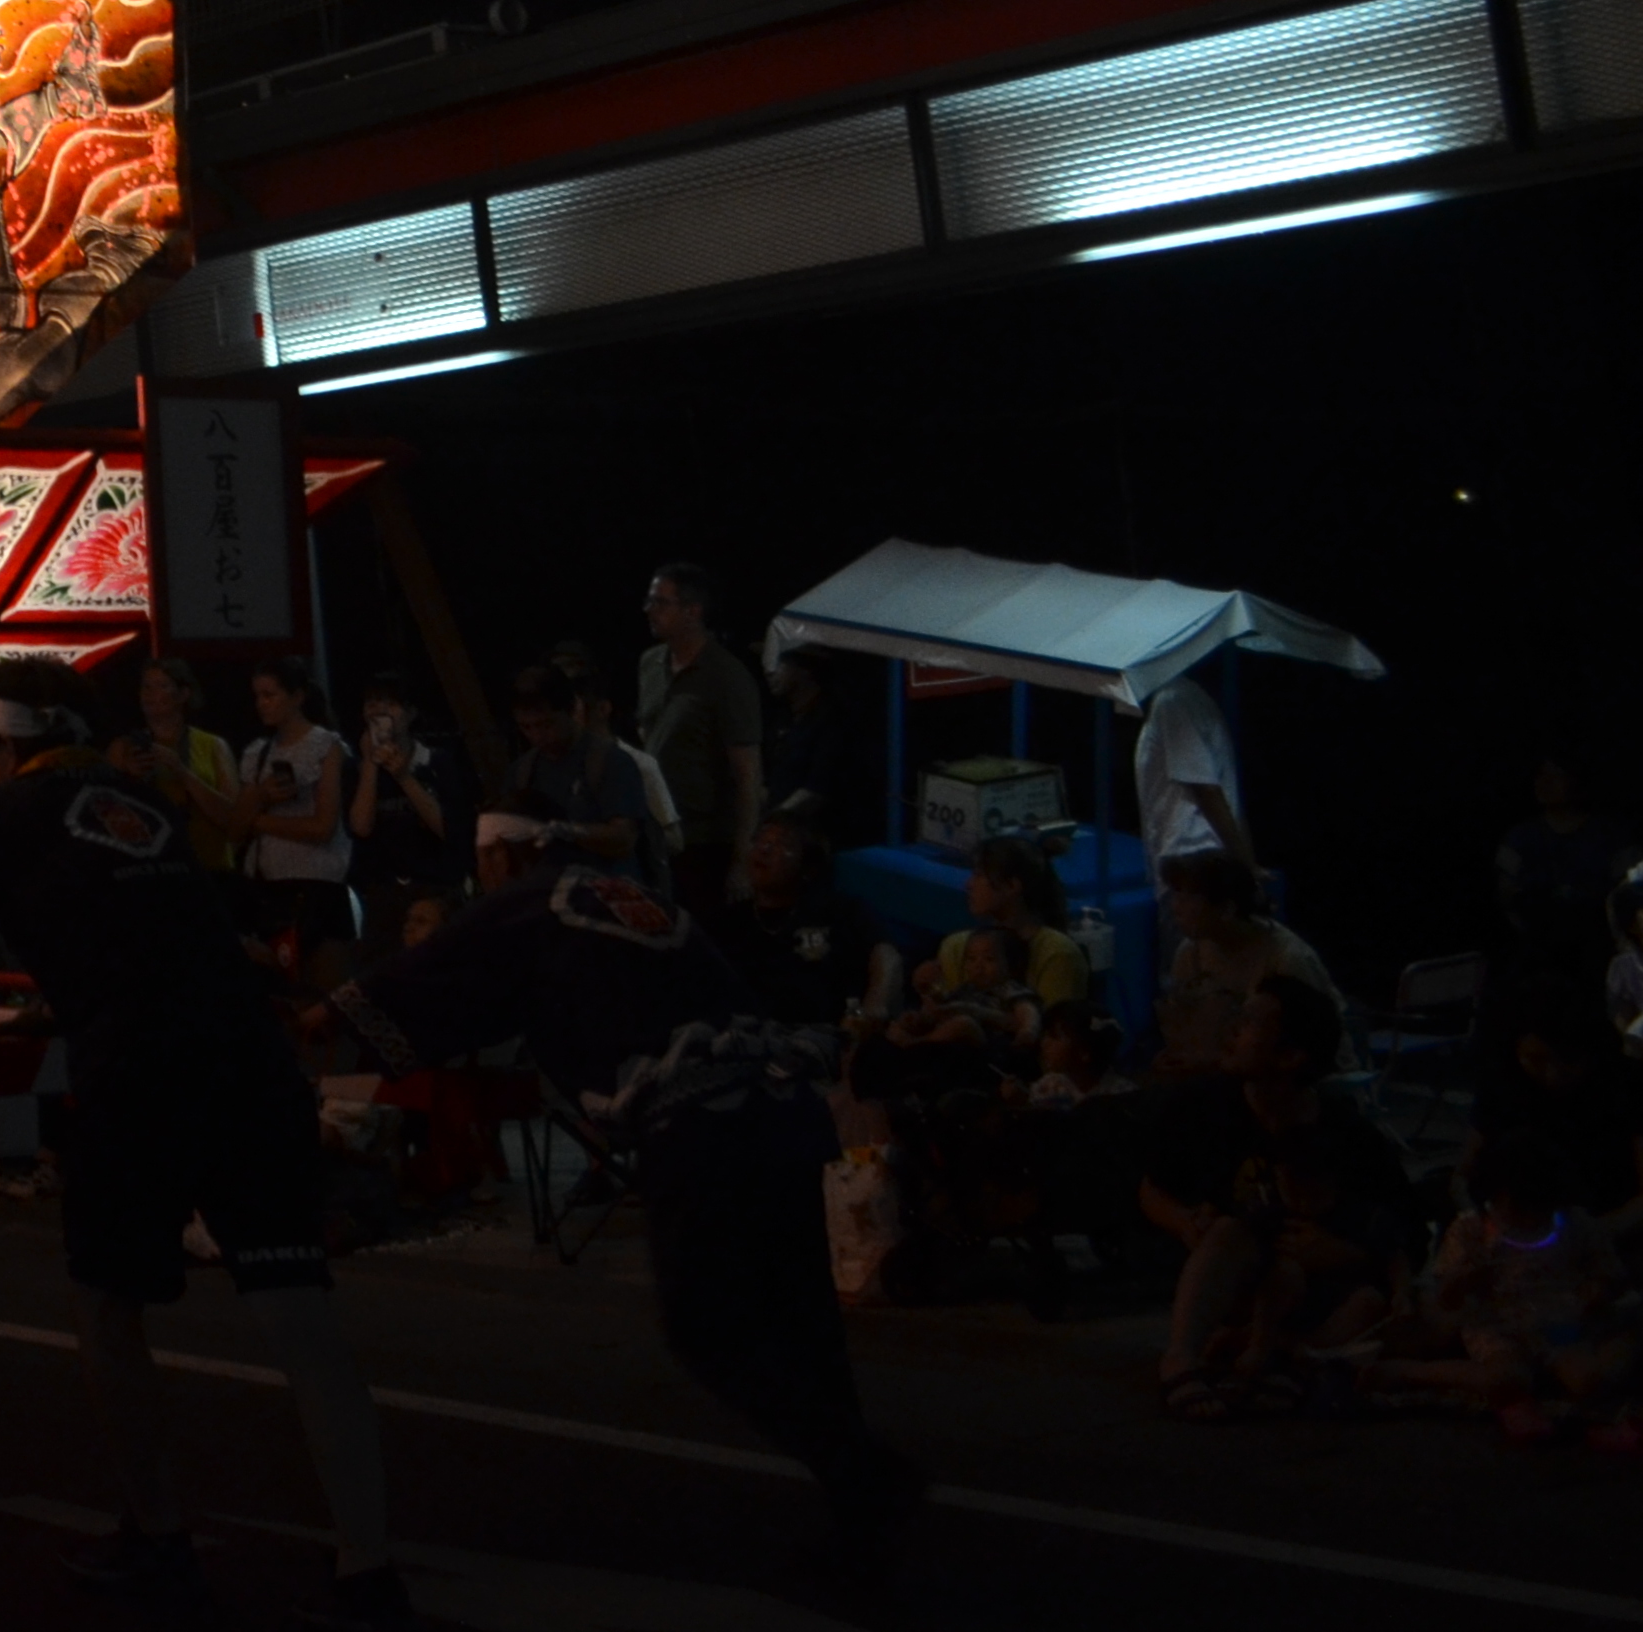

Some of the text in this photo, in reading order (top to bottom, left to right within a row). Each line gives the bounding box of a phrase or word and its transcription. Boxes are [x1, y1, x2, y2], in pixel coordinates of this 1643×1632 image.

[204, 408, 244, 628] 八百屋お七
[927, 802, 965, 827] 200
